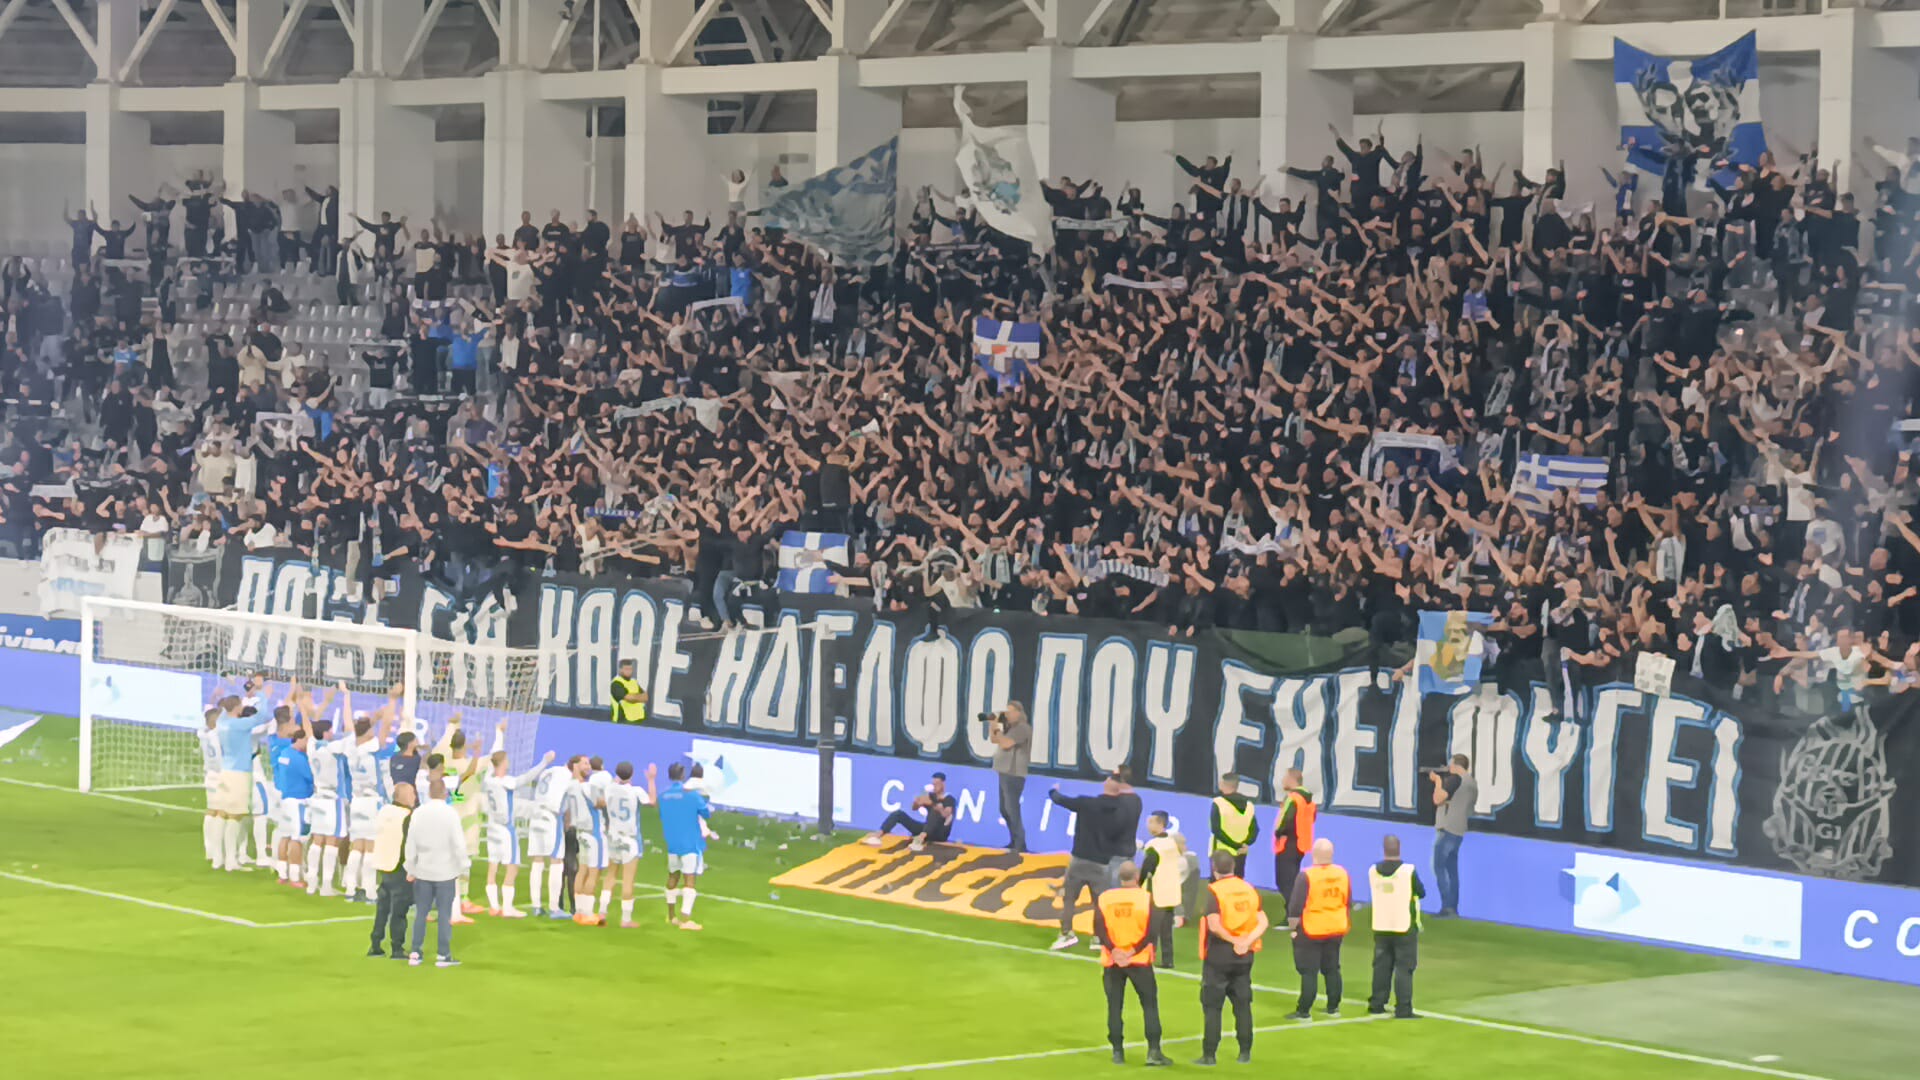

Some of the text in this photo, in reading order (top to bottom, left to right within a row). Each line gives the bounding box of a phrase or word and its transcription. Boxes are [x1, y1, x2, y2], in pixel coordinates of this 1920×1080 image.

[537, 583, 702, 724] ΚΑΘΕ
[1030, 632, 1198, 785] ΠΟΥ
[1213, 658, 1419, 815] ΕΧΕΙ
[1448, 681, 1744, 858] ΦΥΓΕΙ
